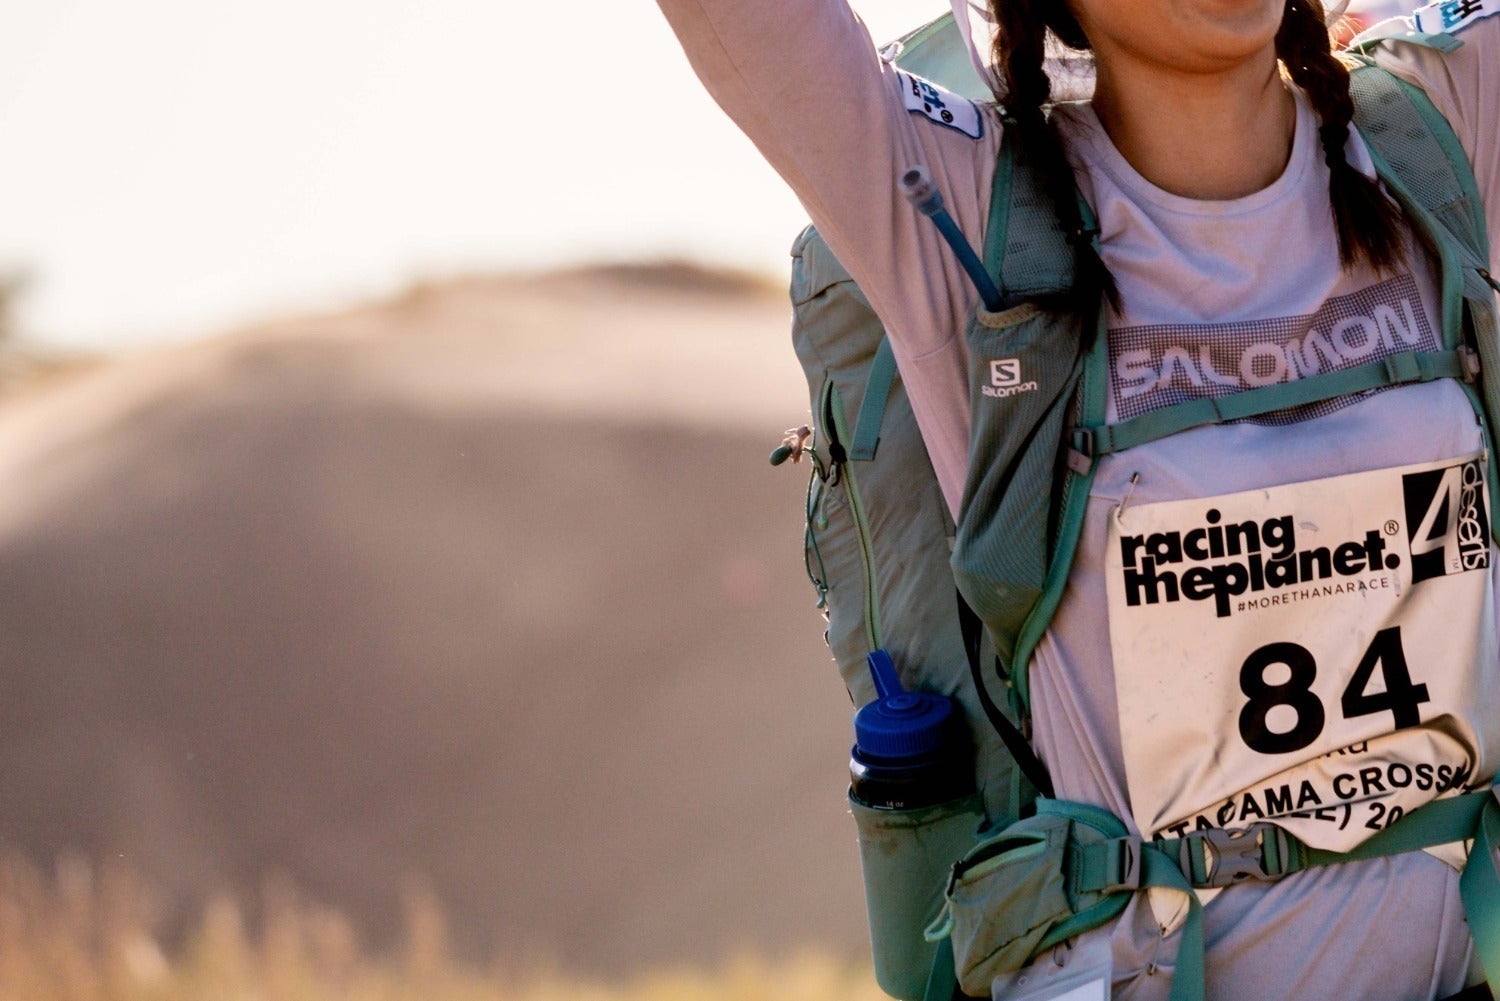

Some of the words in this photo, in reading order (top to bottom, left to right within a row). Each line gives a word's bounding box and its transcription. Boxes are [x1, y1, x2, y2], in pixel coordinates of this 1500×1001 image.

[1116, 299, 1420, 399] SALOMON
[1120, 508, 1296, 567] racing
[1458, 463, 1490, 570] deserts
[1238, 577, 1390, 612] #MORETHANARACE
[1238, 625, 1431, 754] 84
